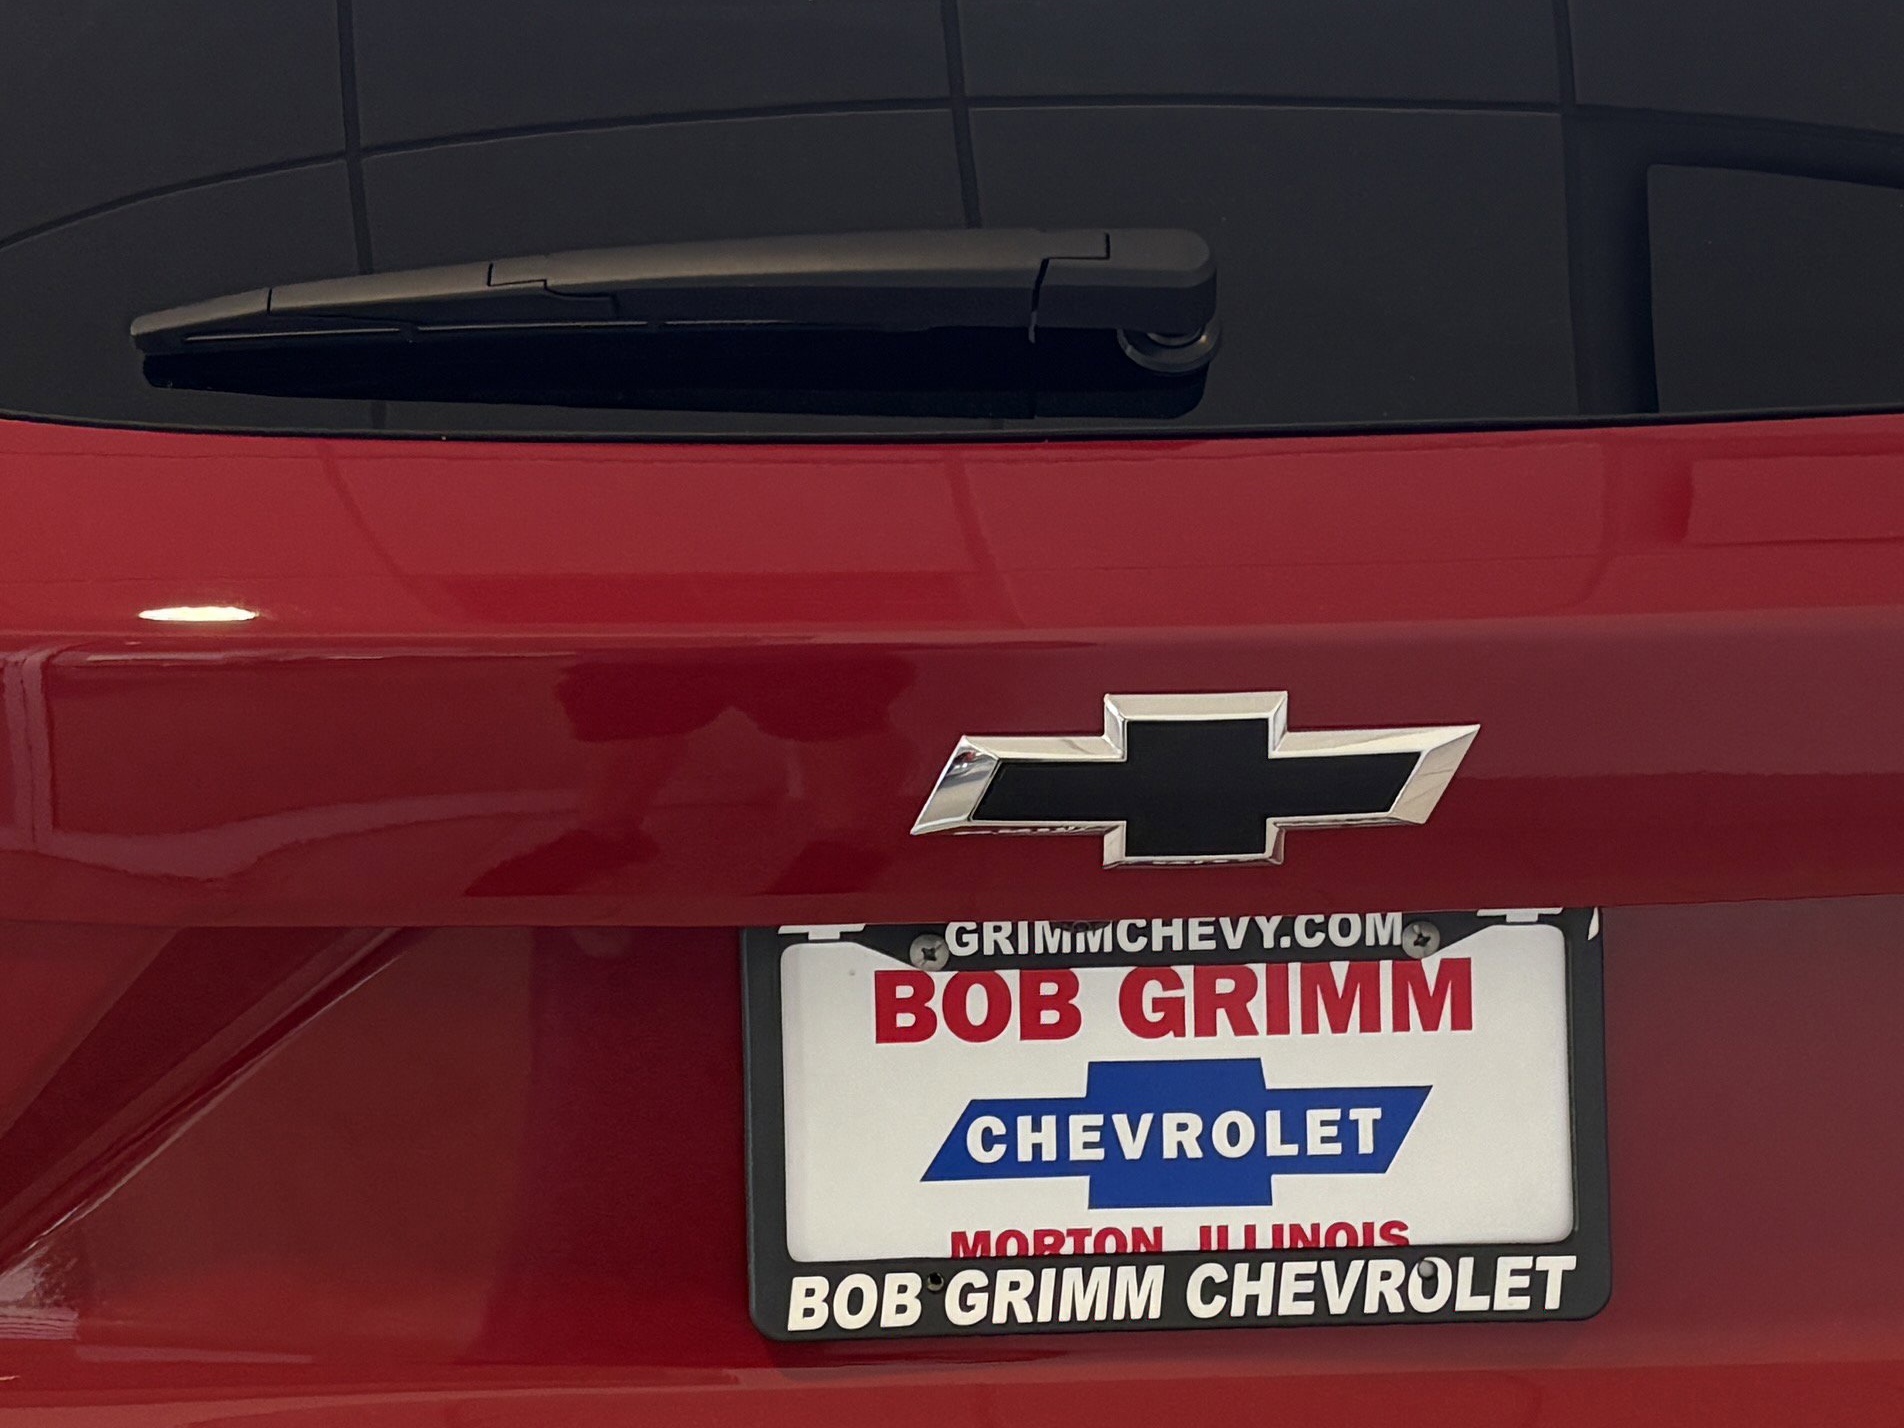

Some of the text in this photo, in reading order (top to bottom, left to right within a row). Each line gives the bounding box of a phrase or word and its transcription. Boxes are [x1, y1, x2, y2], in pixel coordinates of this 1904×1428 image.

[945, 912, 1403, 956] GRIMMCHEVY.COM
[874, 958, 1473, 1044] BOB GRIMM
[966, 1107, 1383, 1163] CHEVROLET
[787, 1255, 1577, 1331] BOB GRIMM CHEVROLET
